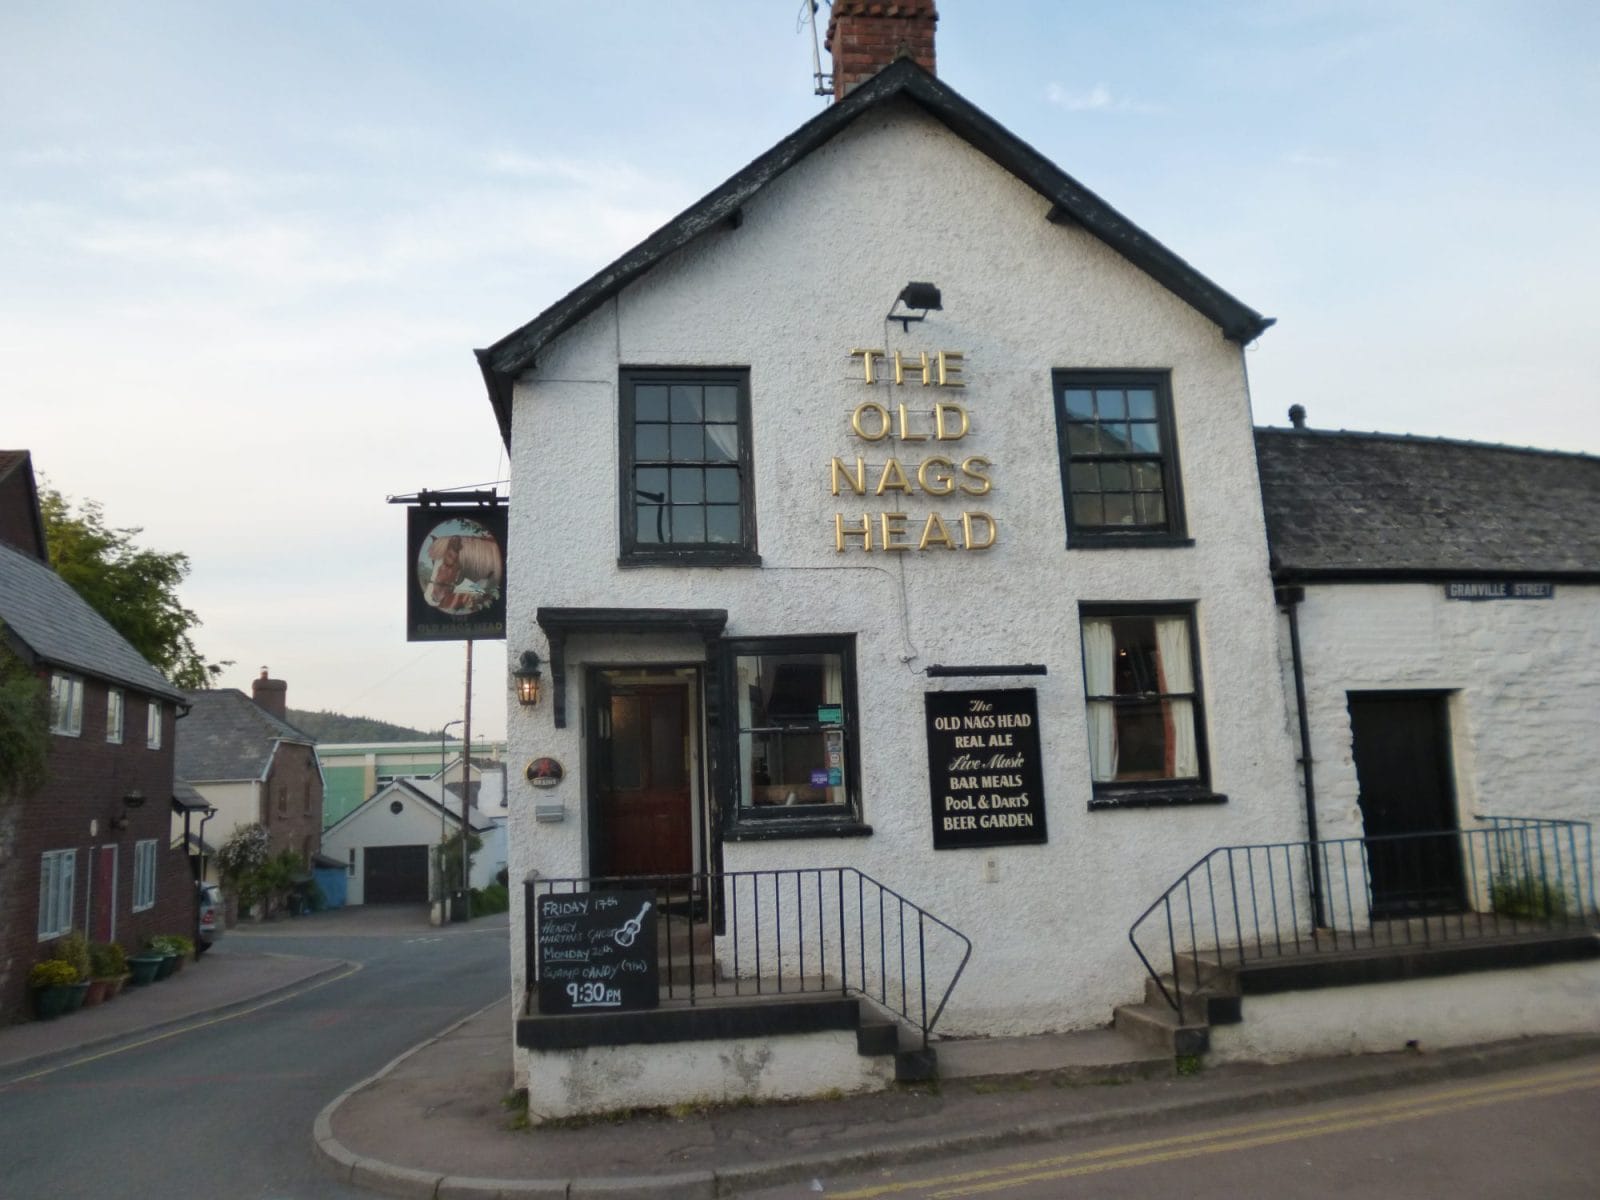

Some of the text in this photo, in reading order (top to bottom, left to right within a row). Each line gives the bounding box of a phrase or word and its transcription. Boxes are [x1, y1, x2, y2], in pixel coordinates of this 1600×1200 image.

[851, 348, 966, 387] THE
[853, 401, 970, 441] OLD
[831, 456, 992, 496] NAGS
[835, 511, 997, 552] HEAD
[1450, 583, 1551, 597] GRANVILLE STREET
[969, 700, 993, 712] The
[935, 714, 1031, 730] OLD NAGS HEAD
[955, 734, 1013, 748] REAL ALE
[949, 752, 1025, 771] Live Music
[950, 775, 1023, 790] BAR MEALS
[978, 794, 989, 809] &
[943, 813, 1034, 831] BEER GARDEN
[543, 900, 589, 916] FRIDAY
[544, 947, 590, 960] MONDAY
